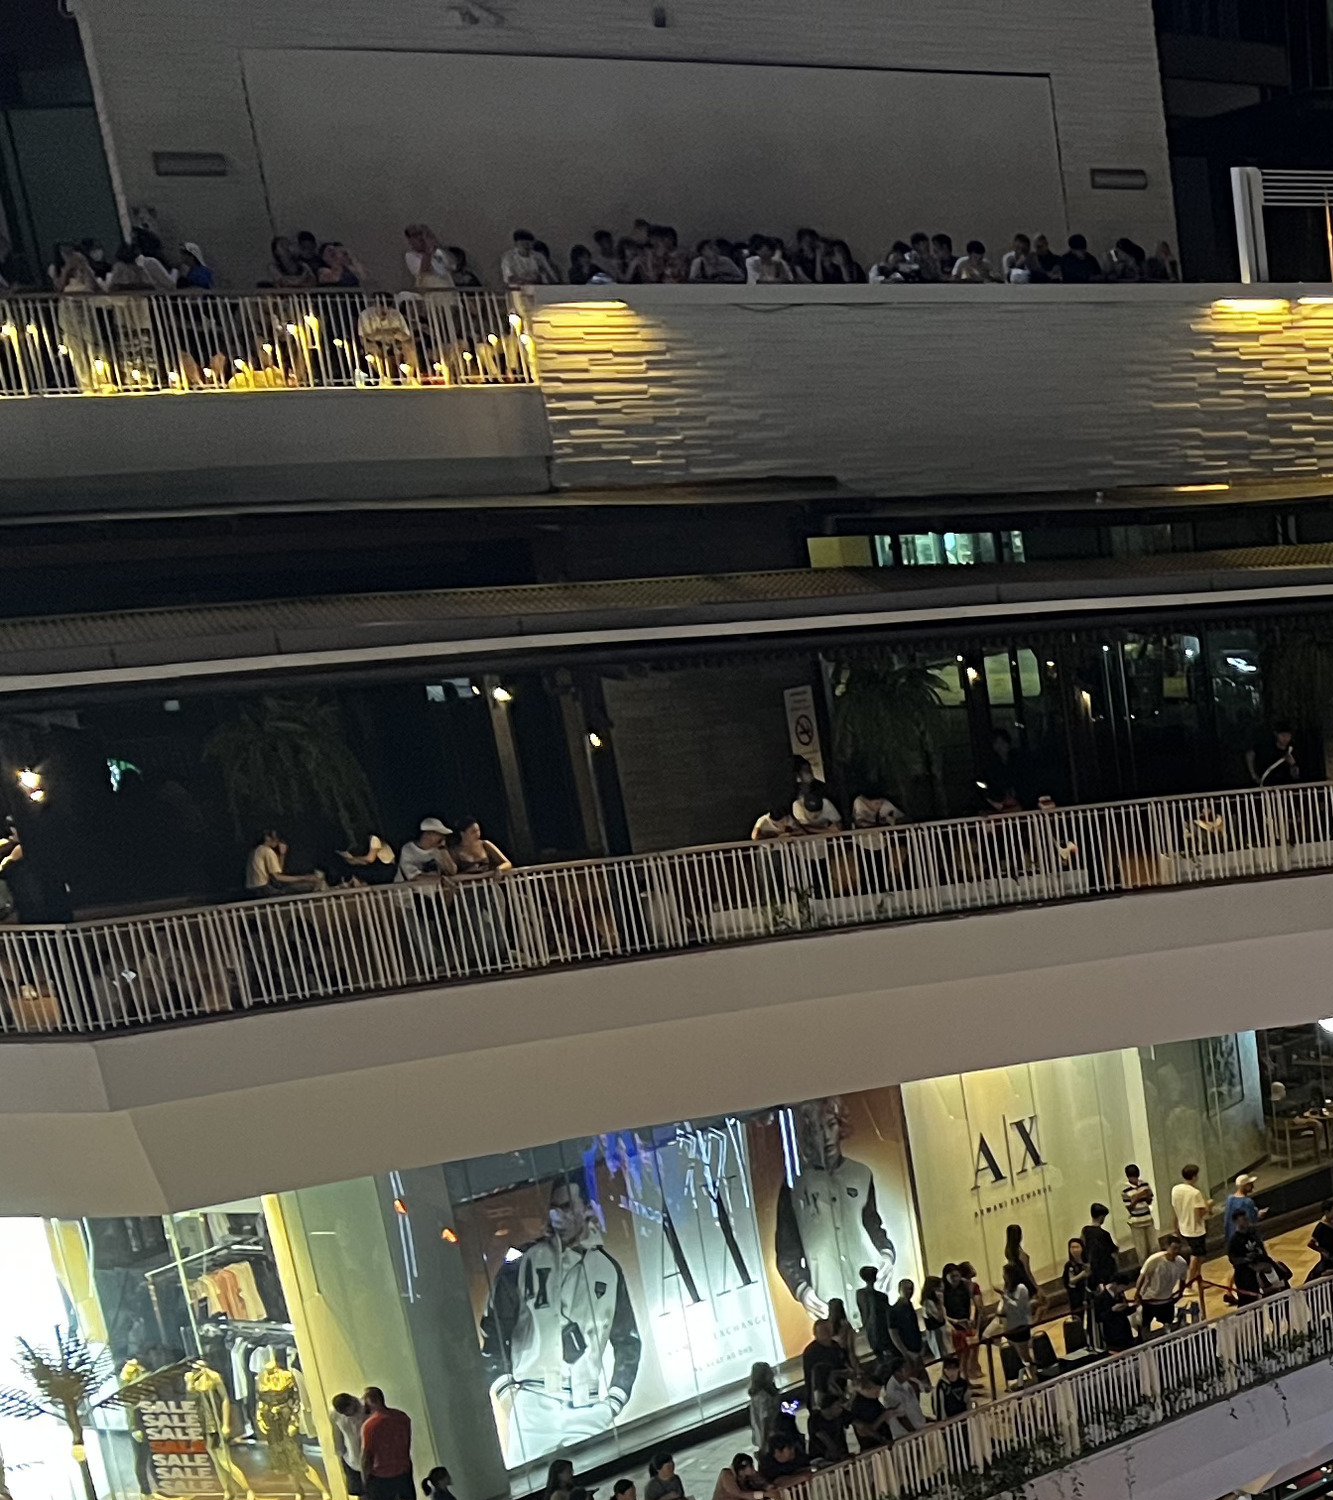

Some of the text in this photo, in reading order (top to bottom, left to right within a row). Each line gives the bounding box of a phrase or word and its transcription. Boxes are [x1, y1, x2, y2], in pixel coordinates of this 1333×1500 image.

[139, 1400, 198, 1414] SALE
[142, 1414, 201, 1427] SALE
[145, 1427, 204, 1440] SALE
[152, 1453, 211, 1467] SALE
[155, 1467, 214, 1479] SALE
